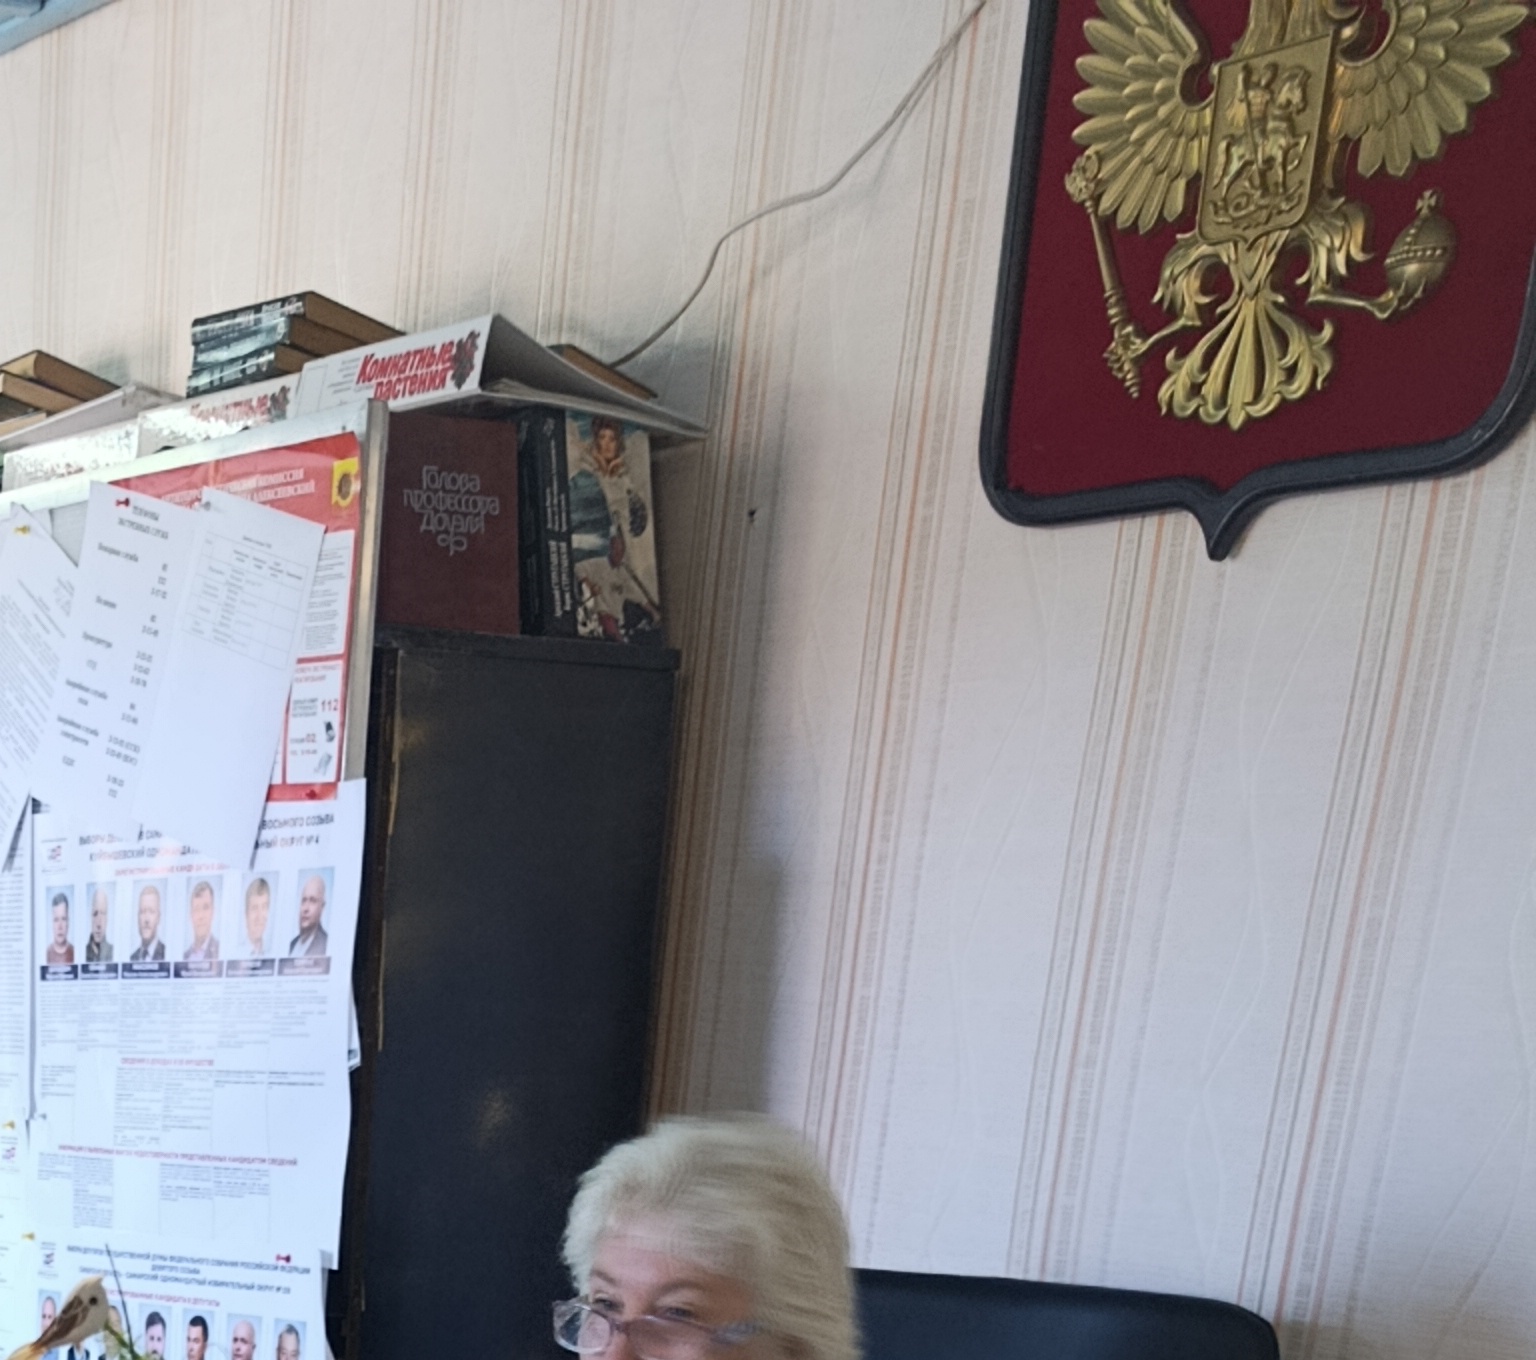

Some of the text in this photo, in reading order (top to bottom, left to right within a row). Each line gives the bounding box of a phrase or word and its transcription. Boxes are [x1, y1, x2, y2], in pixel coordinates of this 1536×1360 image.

[355, 340, 455, 385] Комнатные
[421, 465, 481, 492] Голова
[403, 488, 500, 516] профессора
[419, 508, 485, 553] Доуэля
